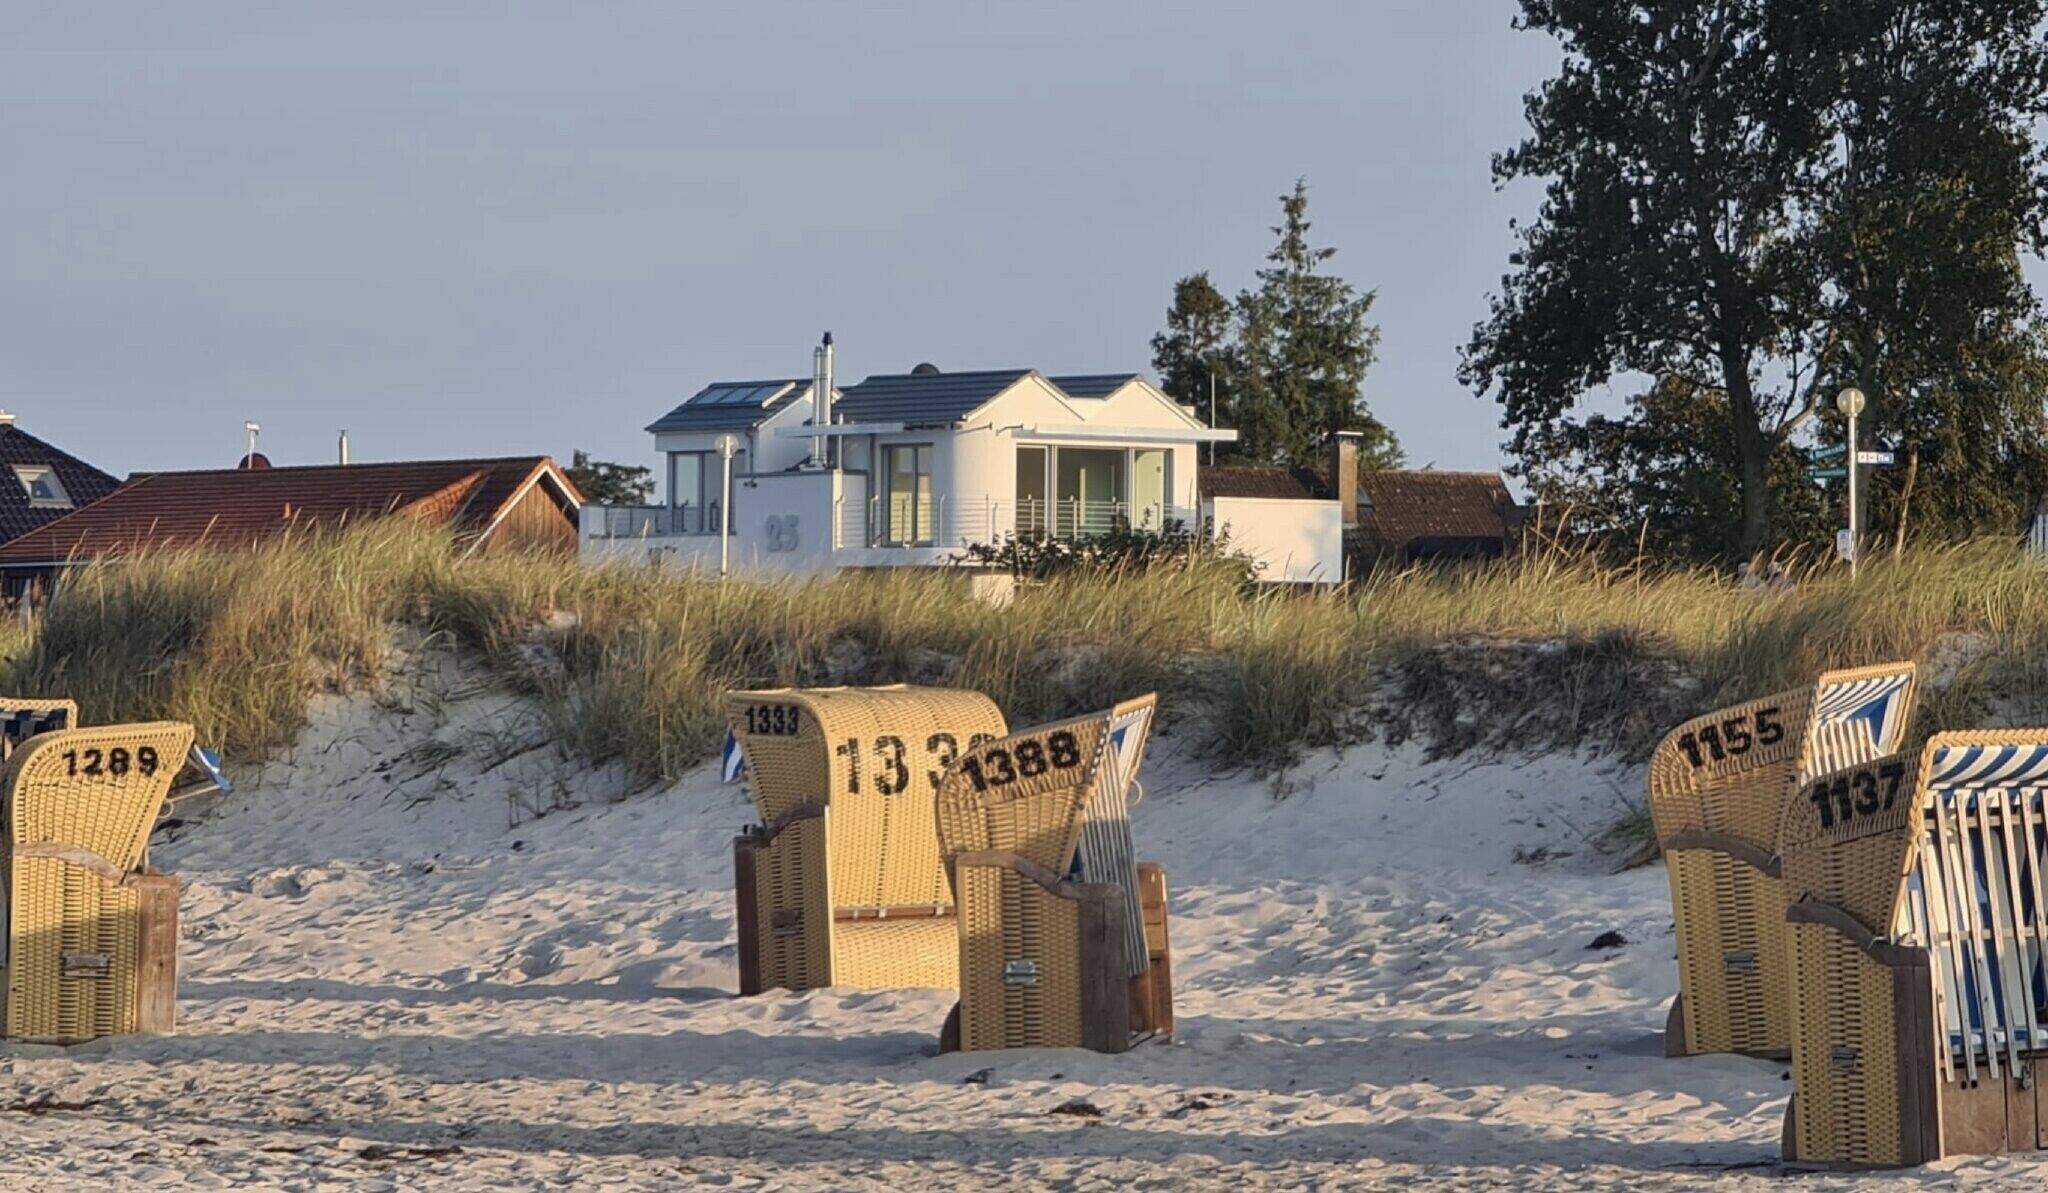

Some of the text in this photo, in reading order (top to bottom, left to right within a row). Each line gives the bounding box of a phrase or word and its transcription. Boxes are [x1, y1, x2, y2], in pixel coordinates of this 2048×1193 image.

[766, 514, 800, 551] 25
[744, 705, 800, 735] 1333
[1678, 707, 1784, 768] 1155
[62, 746, 159, 777] 1289
[960, 730, 1081, 792] 1388
[1810, 762, 1905, 828] 1137
